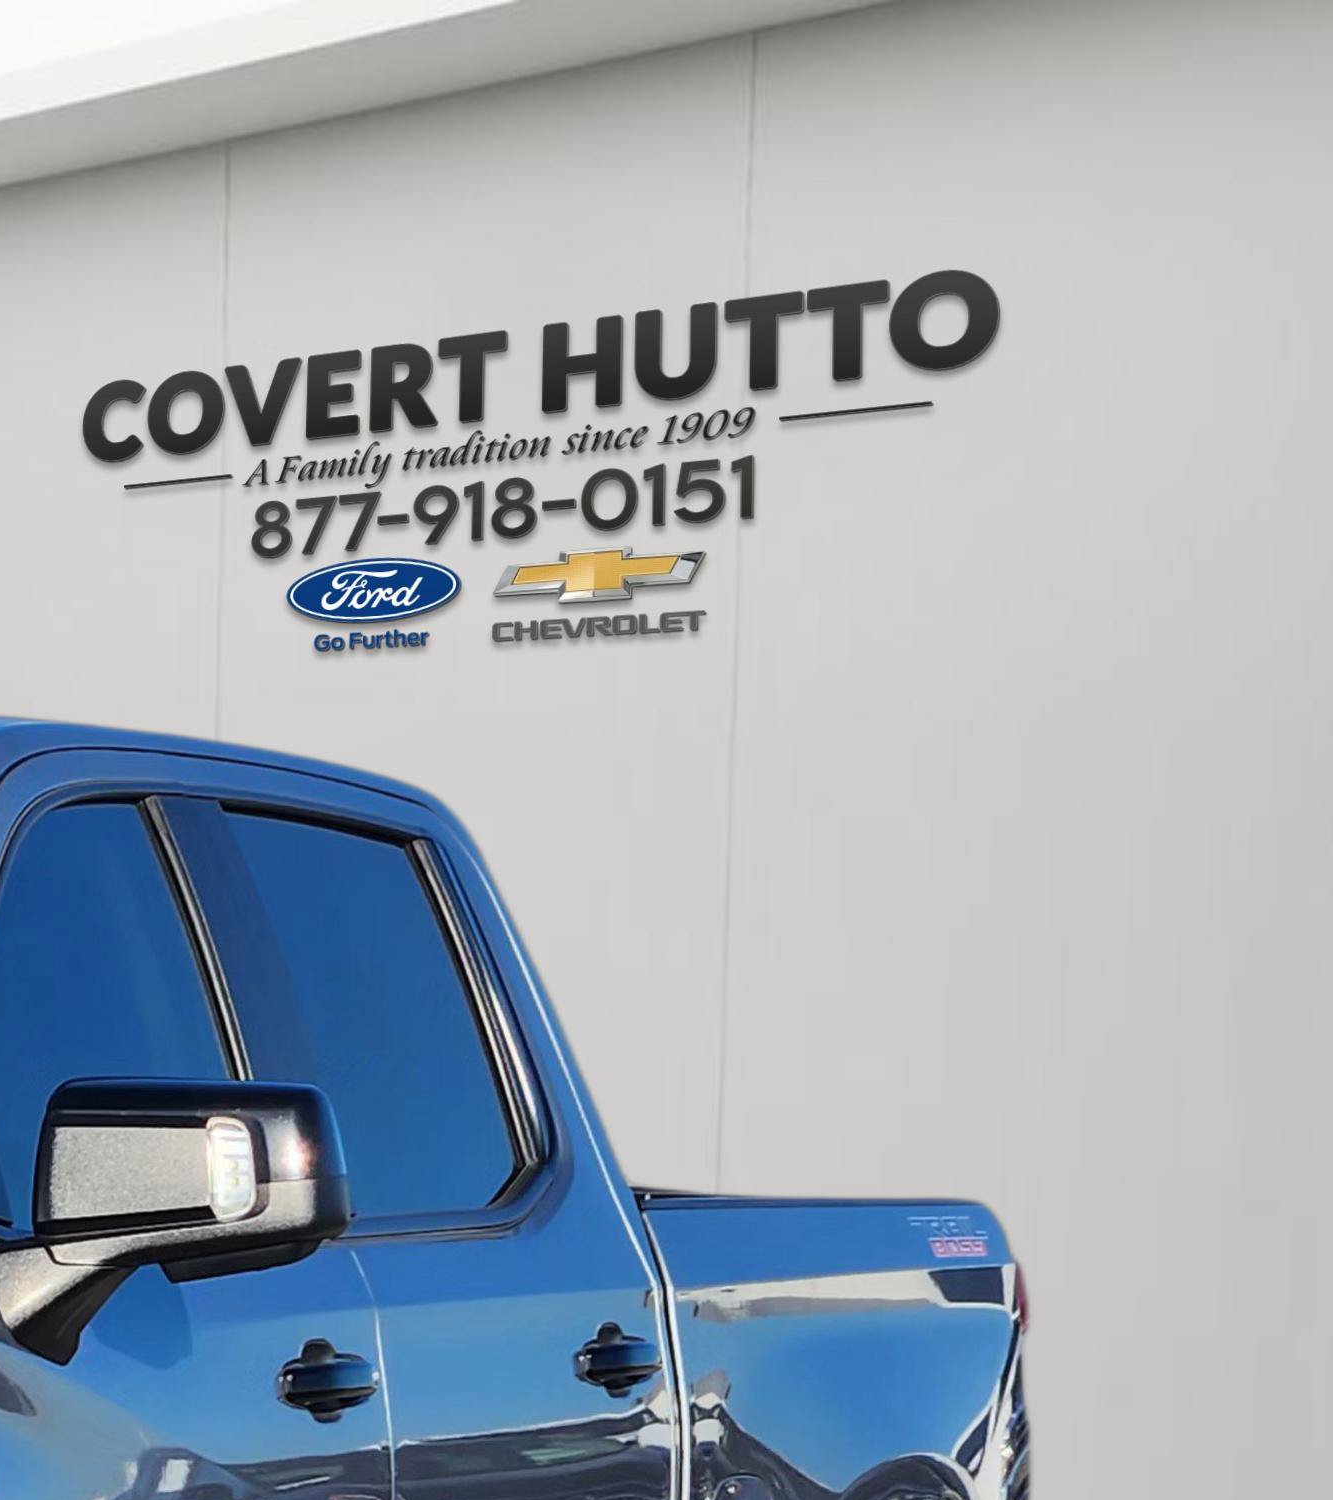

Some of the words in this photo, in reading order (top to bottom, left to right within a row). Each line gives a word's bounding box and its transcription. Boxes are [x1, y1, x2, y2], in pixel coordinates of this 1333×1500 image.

[83, 350, 508, 463] COVERT
[542, 270, 1001, 415] HUTTO
[242, 458, 269, 488] A
[275, 441, 392, 489] Family
[402, 437, 551, 472] tradition
[562, 426, 649, 456] since
[657, 407, 756, 446] 1909
[251, 455, 755, 560] 877-918-0151
[320, 571, 421, 611] Ford
[313, 634, 346, 653] Go
[349, 628, 430, 651] Further
[491, 610, 707, 643] CHEVROLET
